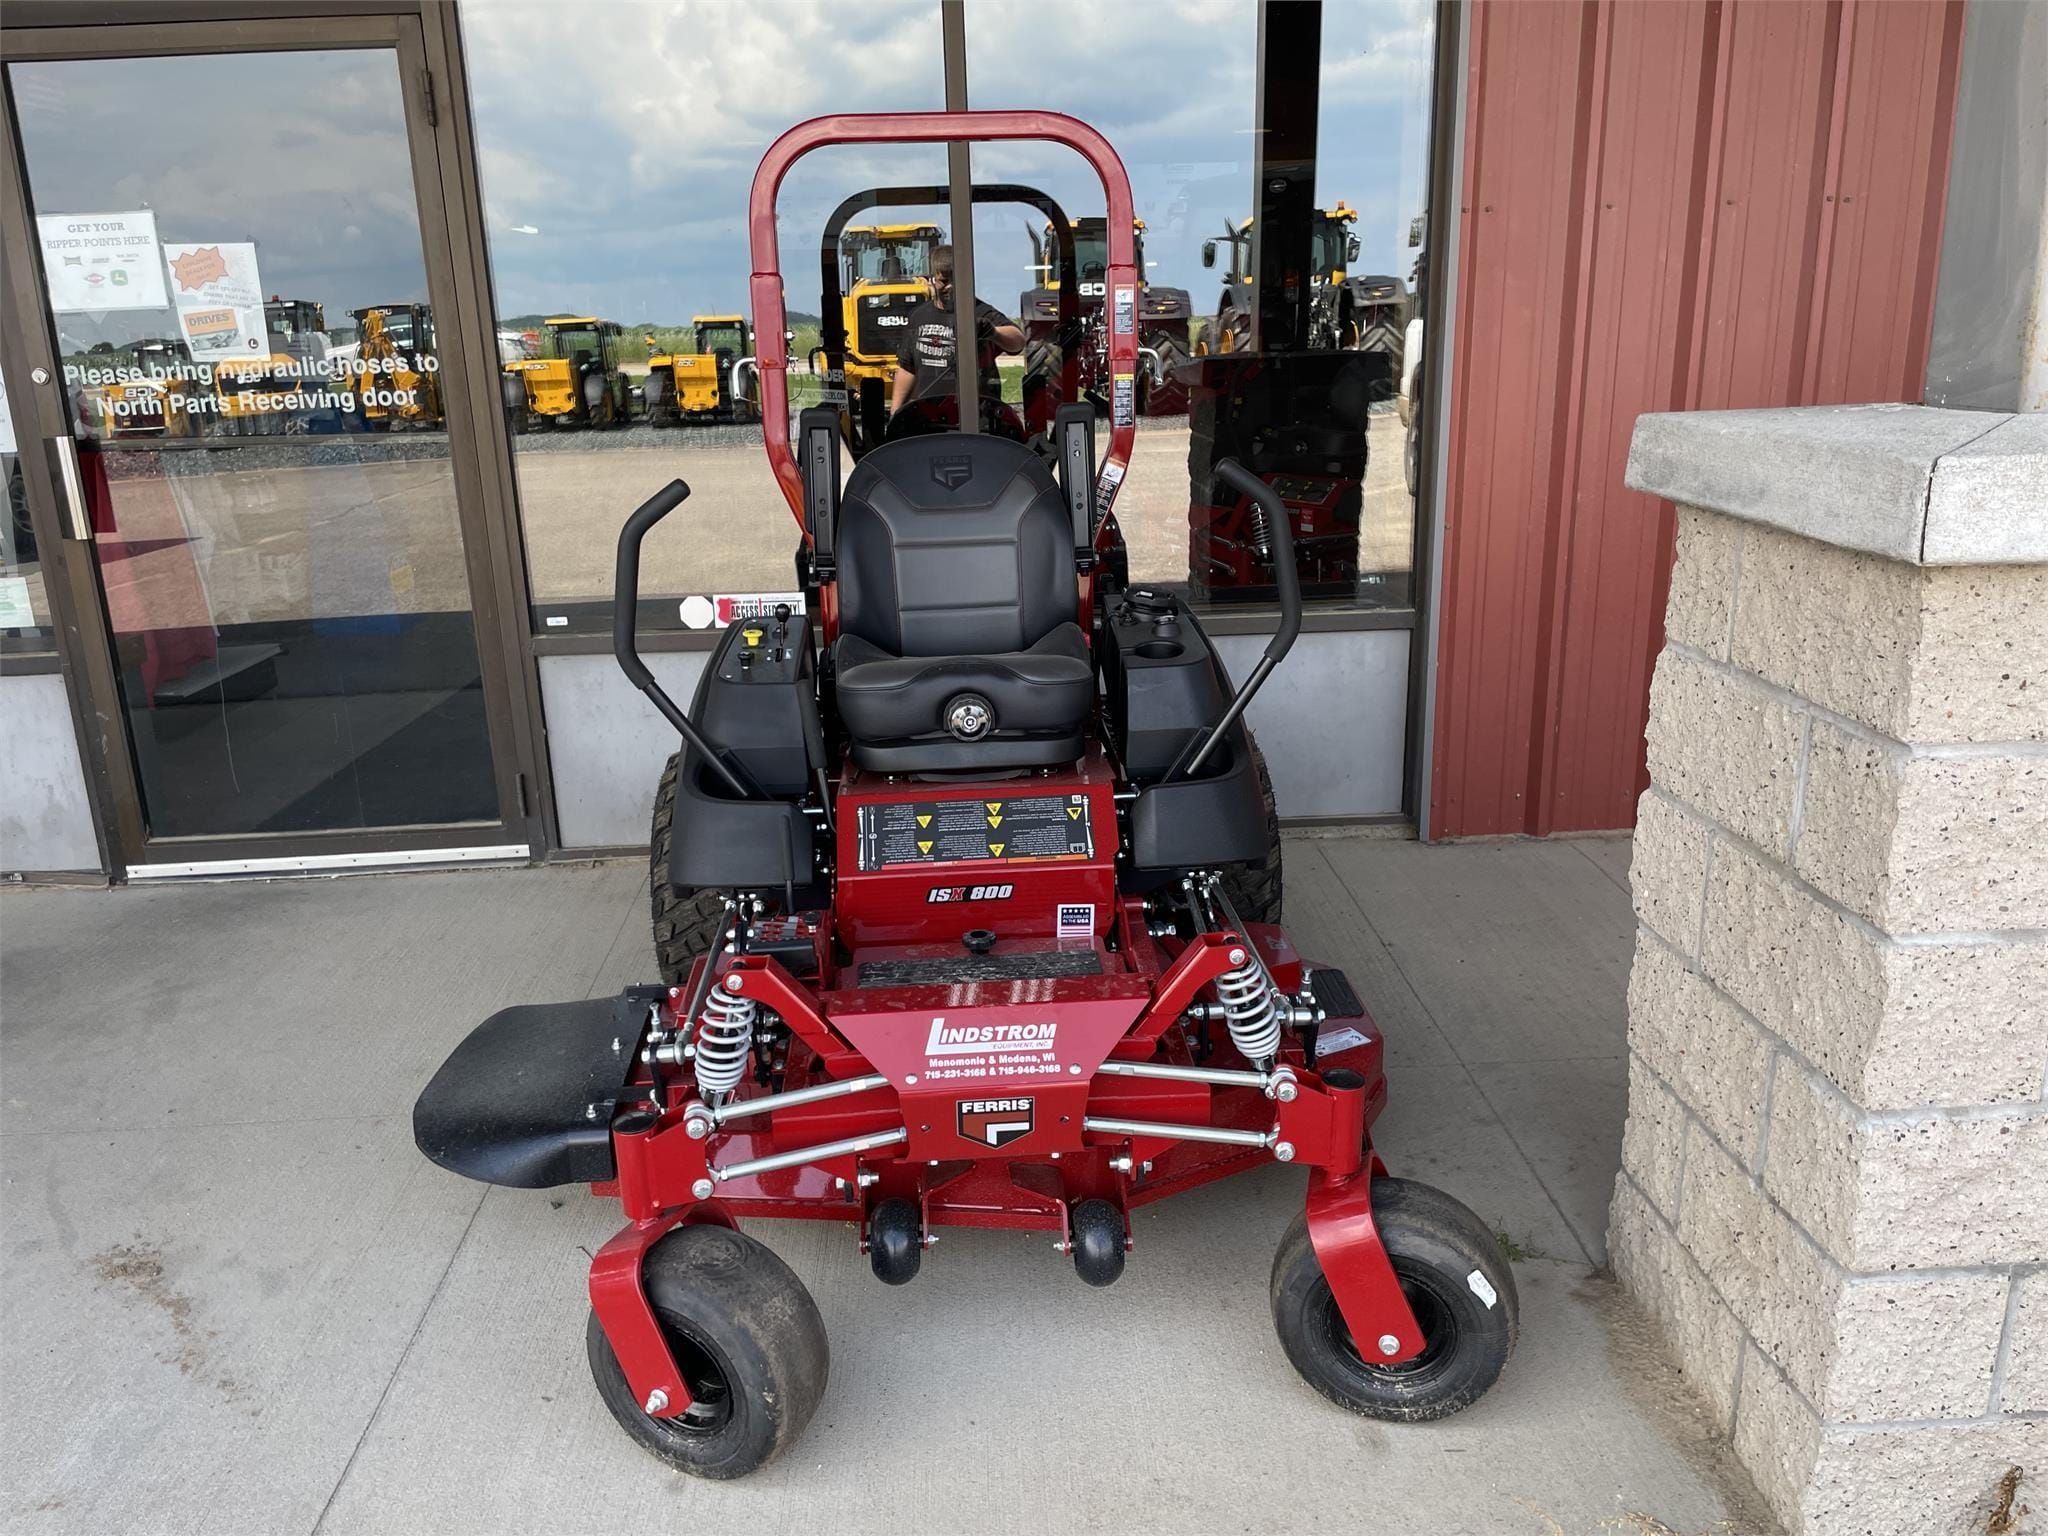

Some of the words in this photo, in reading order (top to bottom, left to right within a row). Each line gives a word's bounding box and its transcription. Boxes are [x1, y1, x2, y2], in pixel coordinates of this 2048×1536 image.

[67, 223, 91, 233] GET
[92, 222, 125, 232] YOUR
[46, 239, 82, 249] RIPPER
[84, 238, 121, 247] POINTS
[124, 235, 151, 246] HERE
[189, 313, 230, 326] DRIVES
[63, 364, 144, 386] Please
[150, 361, 212, 385] bring
[219, 357, 330, 380] hydraulic
[337, 355, 410, 375] hoses
[415, 354, 440, 372] to
[97, 396, 163, 417] North
[169, 393, 232, 414] Parts
[239, 389, 356, 413] Receiving
[362, 387, 417, 406] door
[731, 605, 759, 618] ACCESS
[928, 888, 966, 902] ISX
[970, 884, 1014, 900] 800
[924, 1017, 1057, 1055] LINDSTROM
[929, 1055, 983, 1068] Menomonie
[1042, 1052, 1056, 1063] WI
[961, 1099, 1031, 1114] FERRIS
